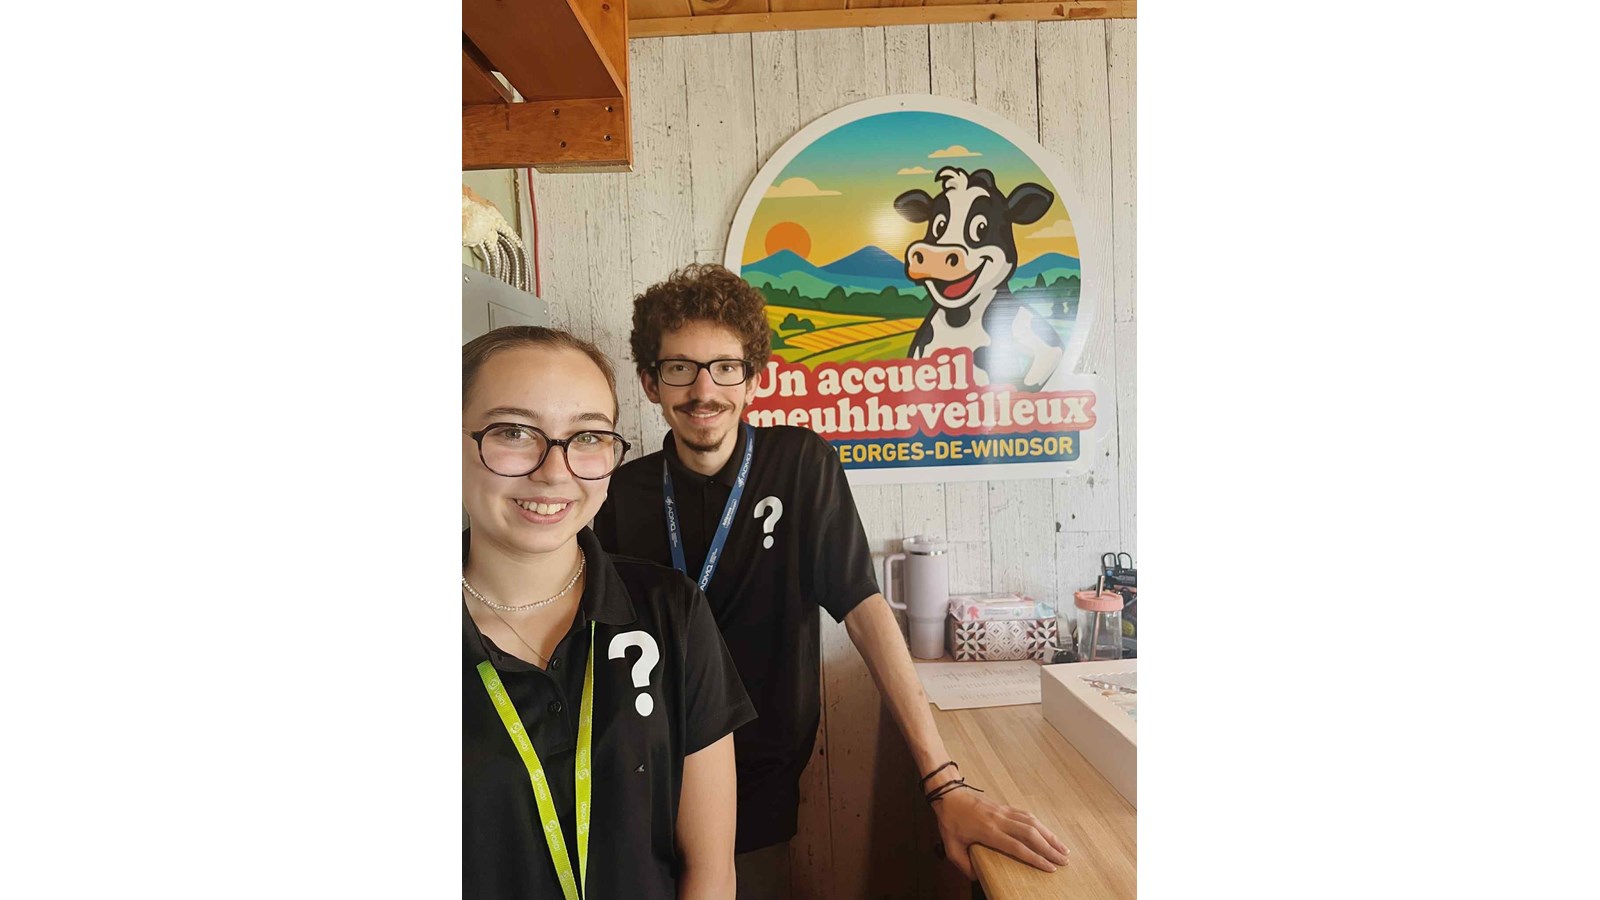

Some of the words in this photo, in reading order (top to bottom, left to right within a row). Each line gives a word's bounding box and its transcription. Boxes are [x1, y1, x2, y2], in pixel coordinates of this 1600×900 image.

[817, 353, 969, 395] accueil
[747, 389, 1089, 434] meuhhrveilleux
[833, 436, 1074, 463] EORGES-DE-WINDSOR
